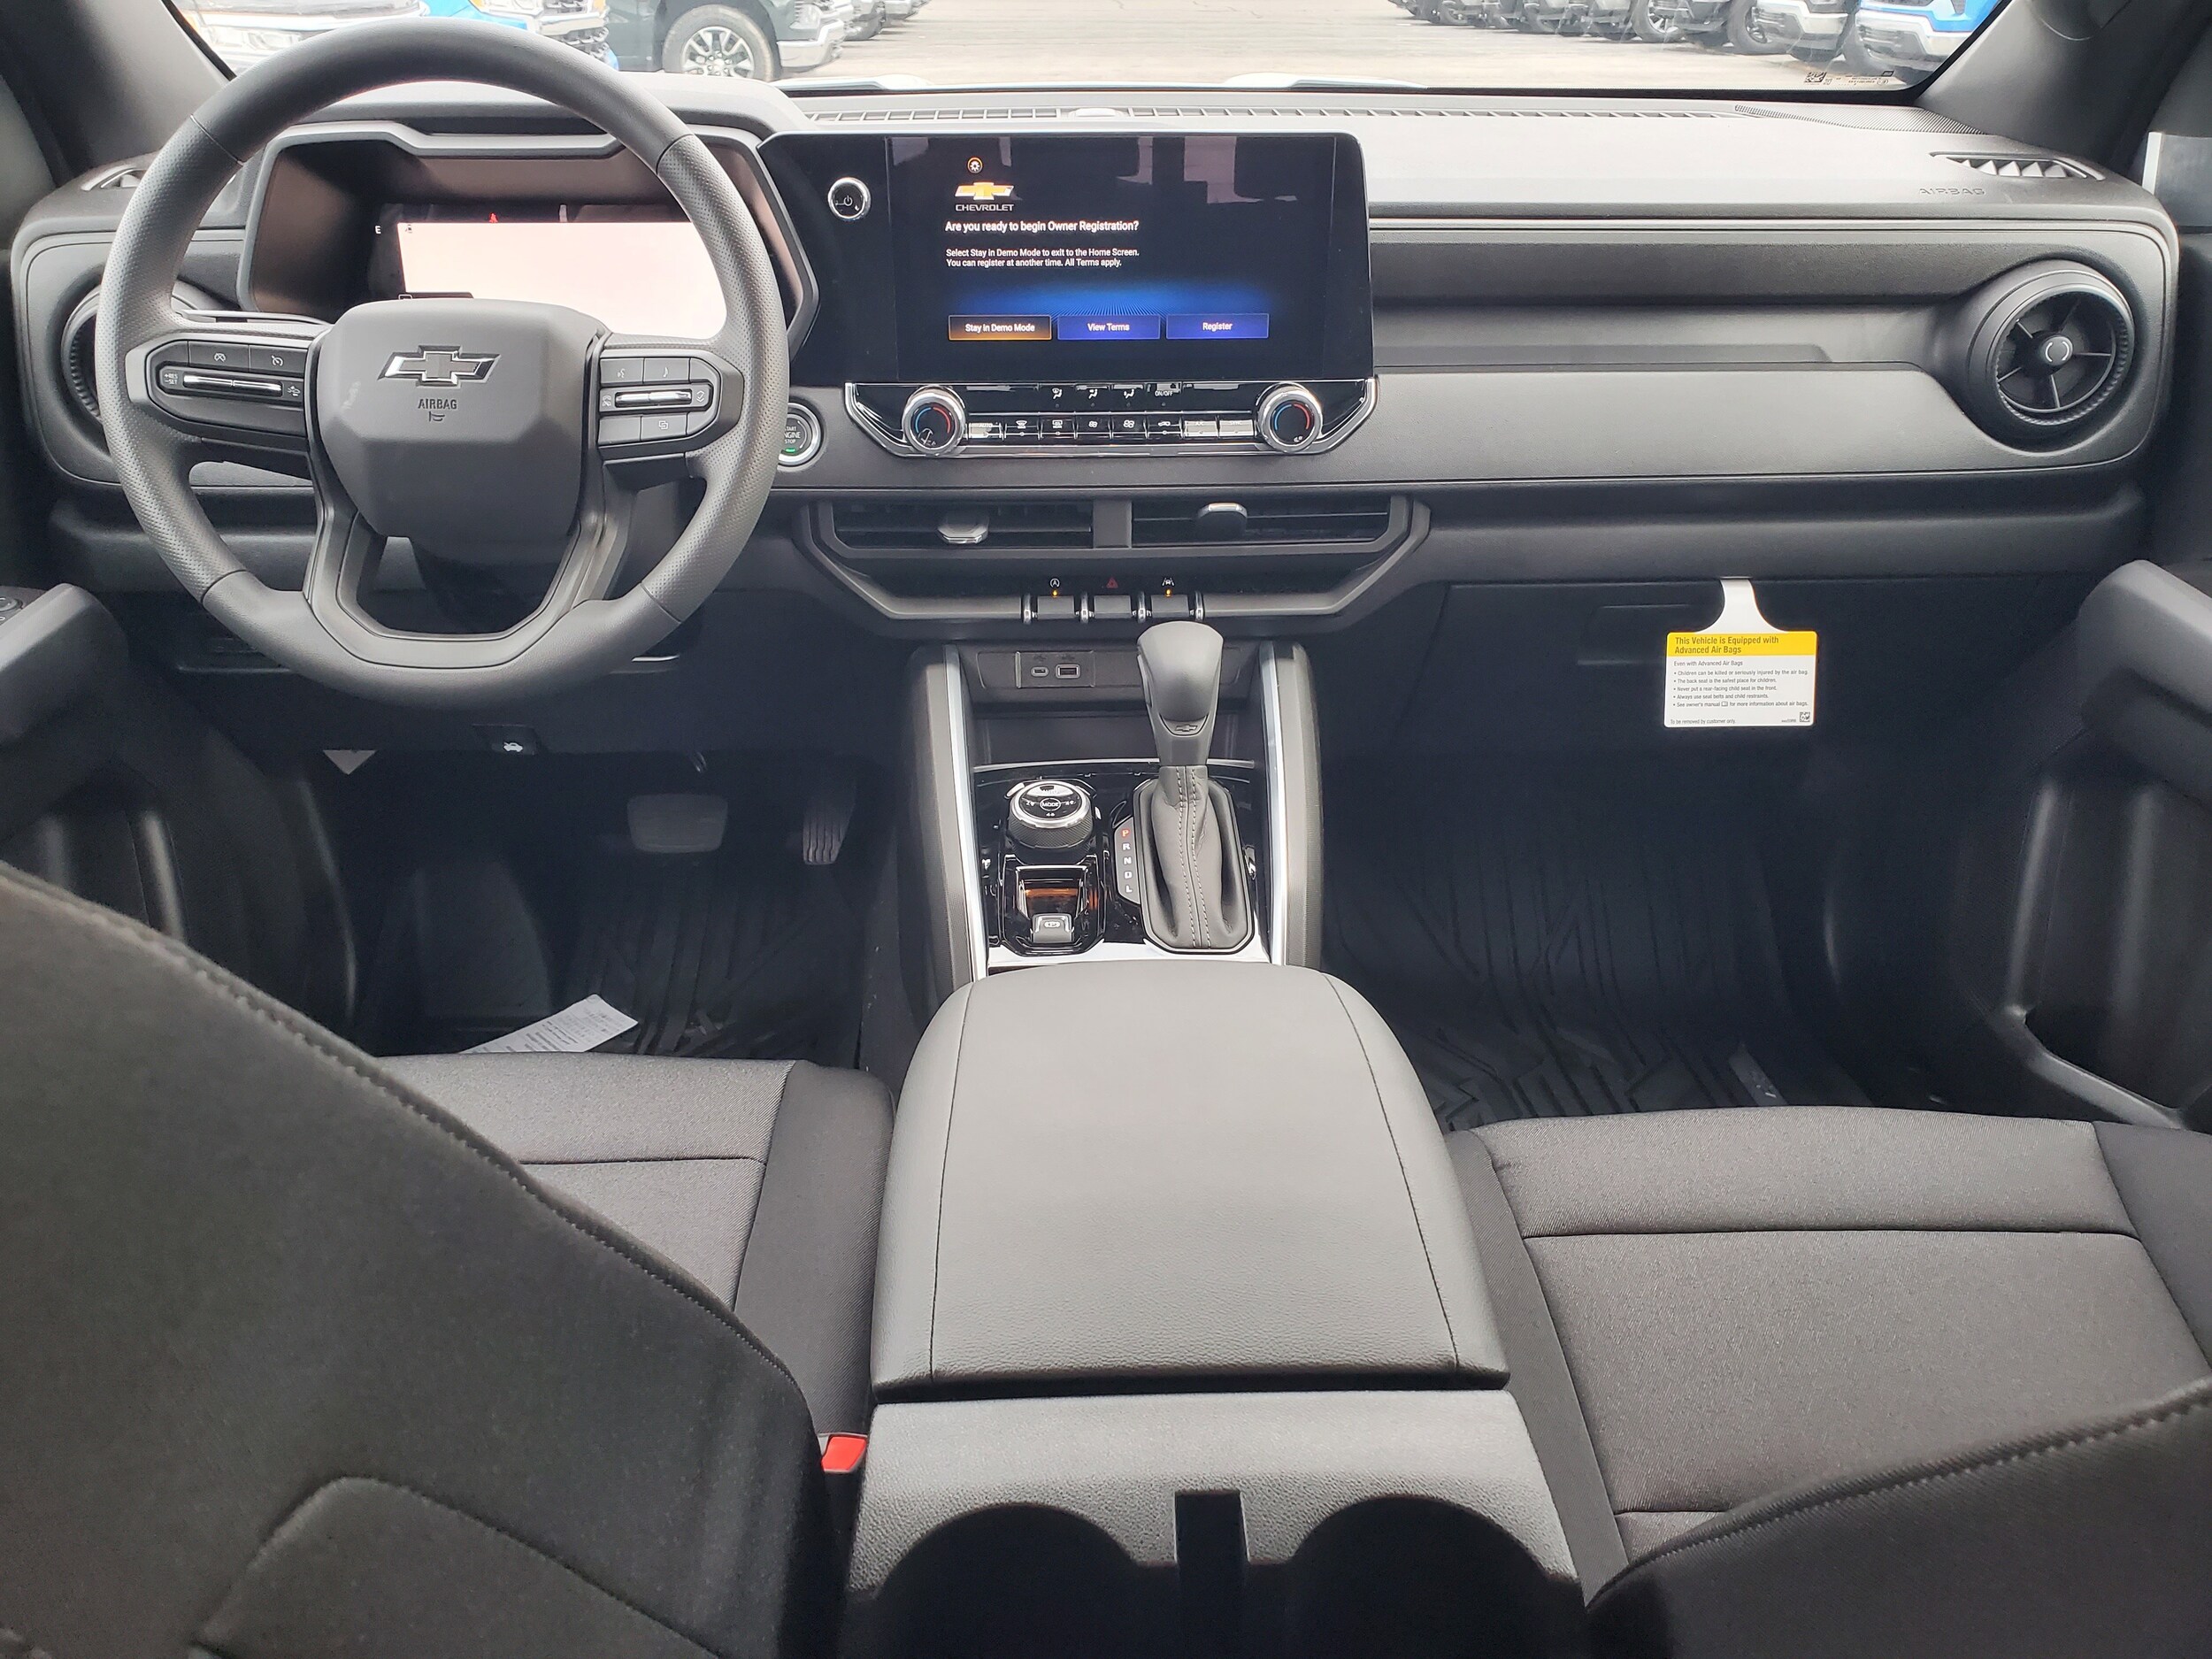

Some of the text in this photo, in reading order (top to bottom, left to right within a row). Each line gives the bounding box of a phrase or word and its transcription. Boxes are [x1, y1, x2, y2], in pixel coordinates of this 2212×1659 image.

[945, 221, 1140, 233] Are you ready to begin Owner Registration?
[970, 249, 987, 258] Stay
[977, 258, 1005, 268] register
[1101, 258, 1122, 267] apply.
[965, 324, 982, 334] Stay
[1202, 322, 1233, 332] Register
[418, 398, 457, 411] AIRBAG
[1727, 636, 1761, 646] Equipped
[1763, 635, 1779, 644] with
[1724, 646, 1742, 655] Bags
